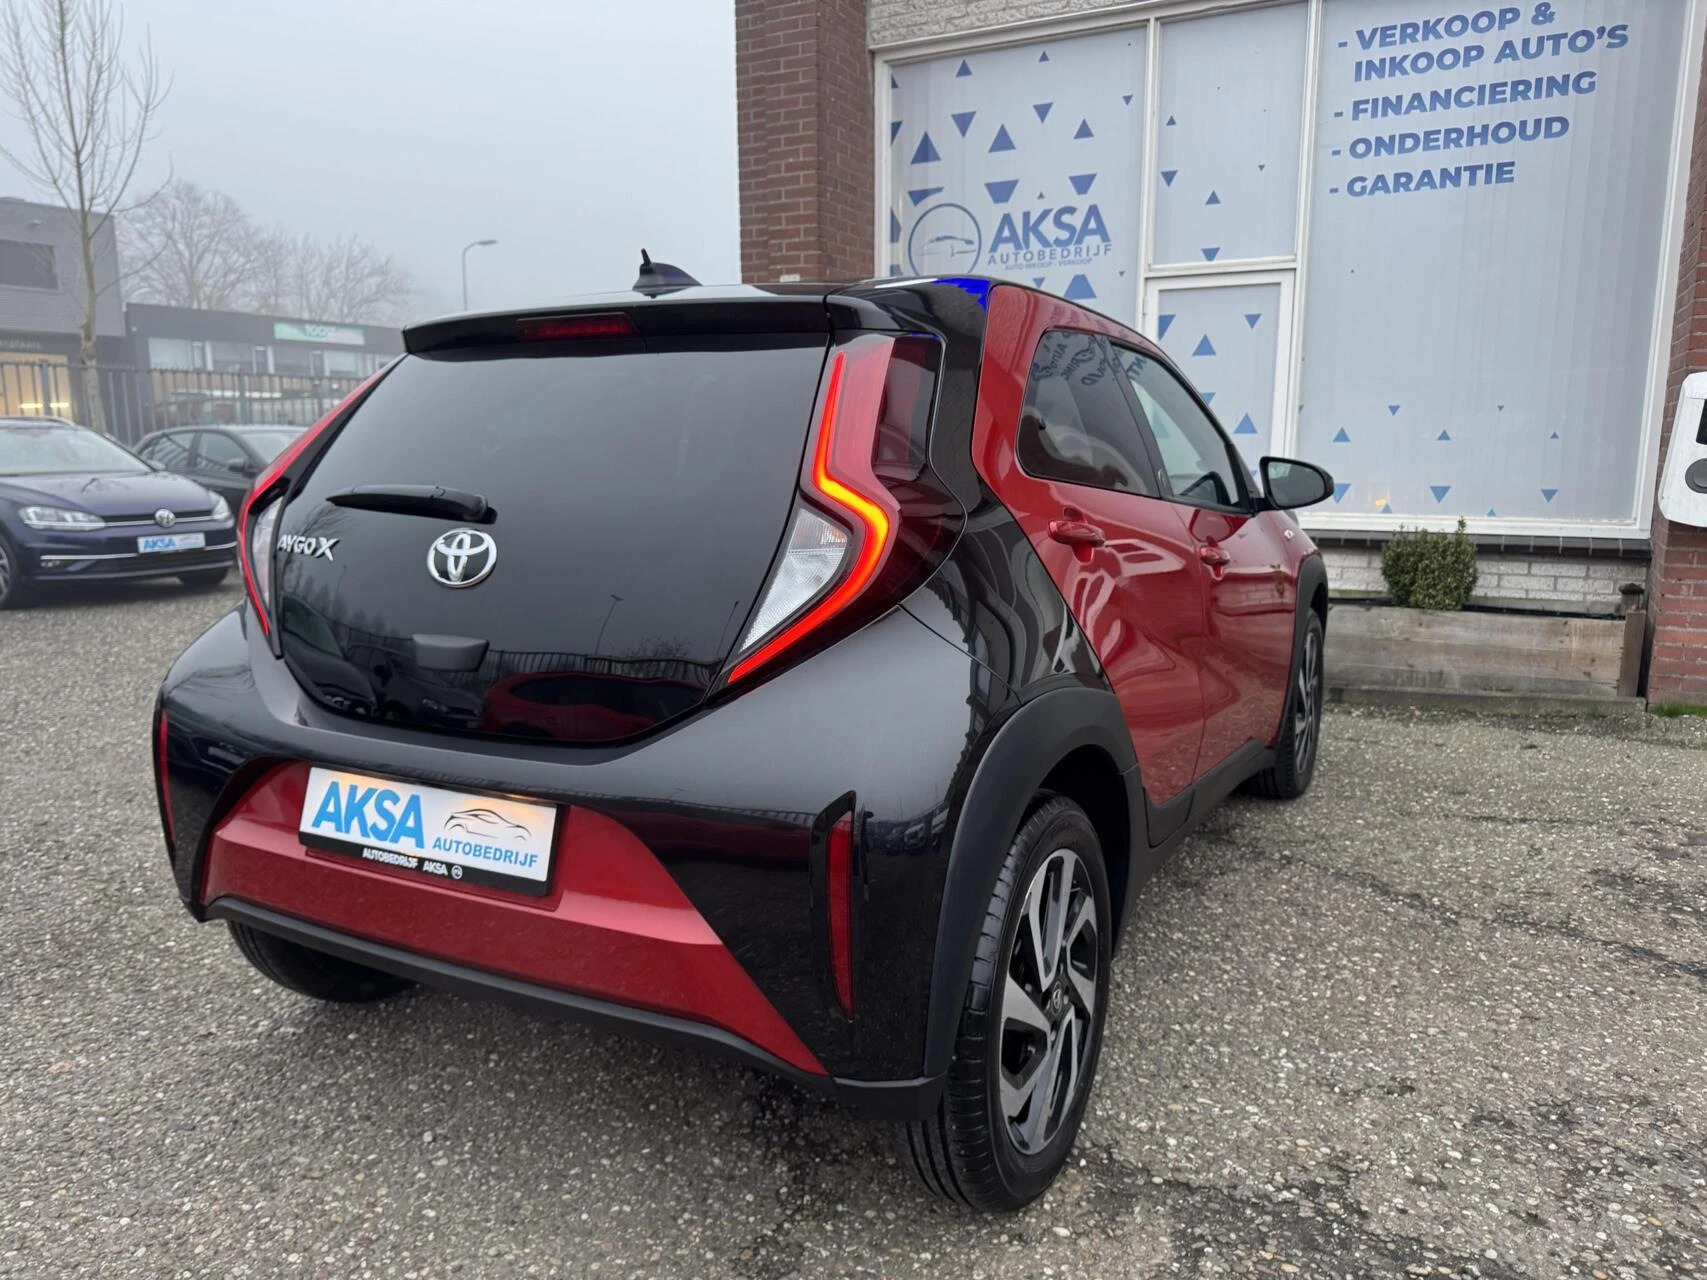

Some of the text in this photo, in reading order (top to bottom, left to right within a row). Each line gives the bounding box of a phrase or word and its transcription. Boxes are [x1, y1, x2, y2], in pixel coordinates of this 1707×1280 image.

[1355, 7, 1520, 50] VERKOOP
[1531, 2, 1555, 26] &
[1354, 24, 1629, 82] INKOOP AUTO'S
[1351, 71, 1597, 121] FINANCIERING
[1349, 116, 1570, 160] ONDERHOUD
[1347, 161, 1516, 197] GARANTIE
[988, 204, 1111, 254] AKSA
[987, 243, 1113, 266] AUTOBEDRIJF
[277, 534, 317, 555] AYGO
[311, 780, 425, 849] AKSA
[361, 847, 419, 869] AUTOBEDRIJF
[422, 860, 449, 877] AKSA
[432, 836, 539, 869] AUTOBEDRIJF
